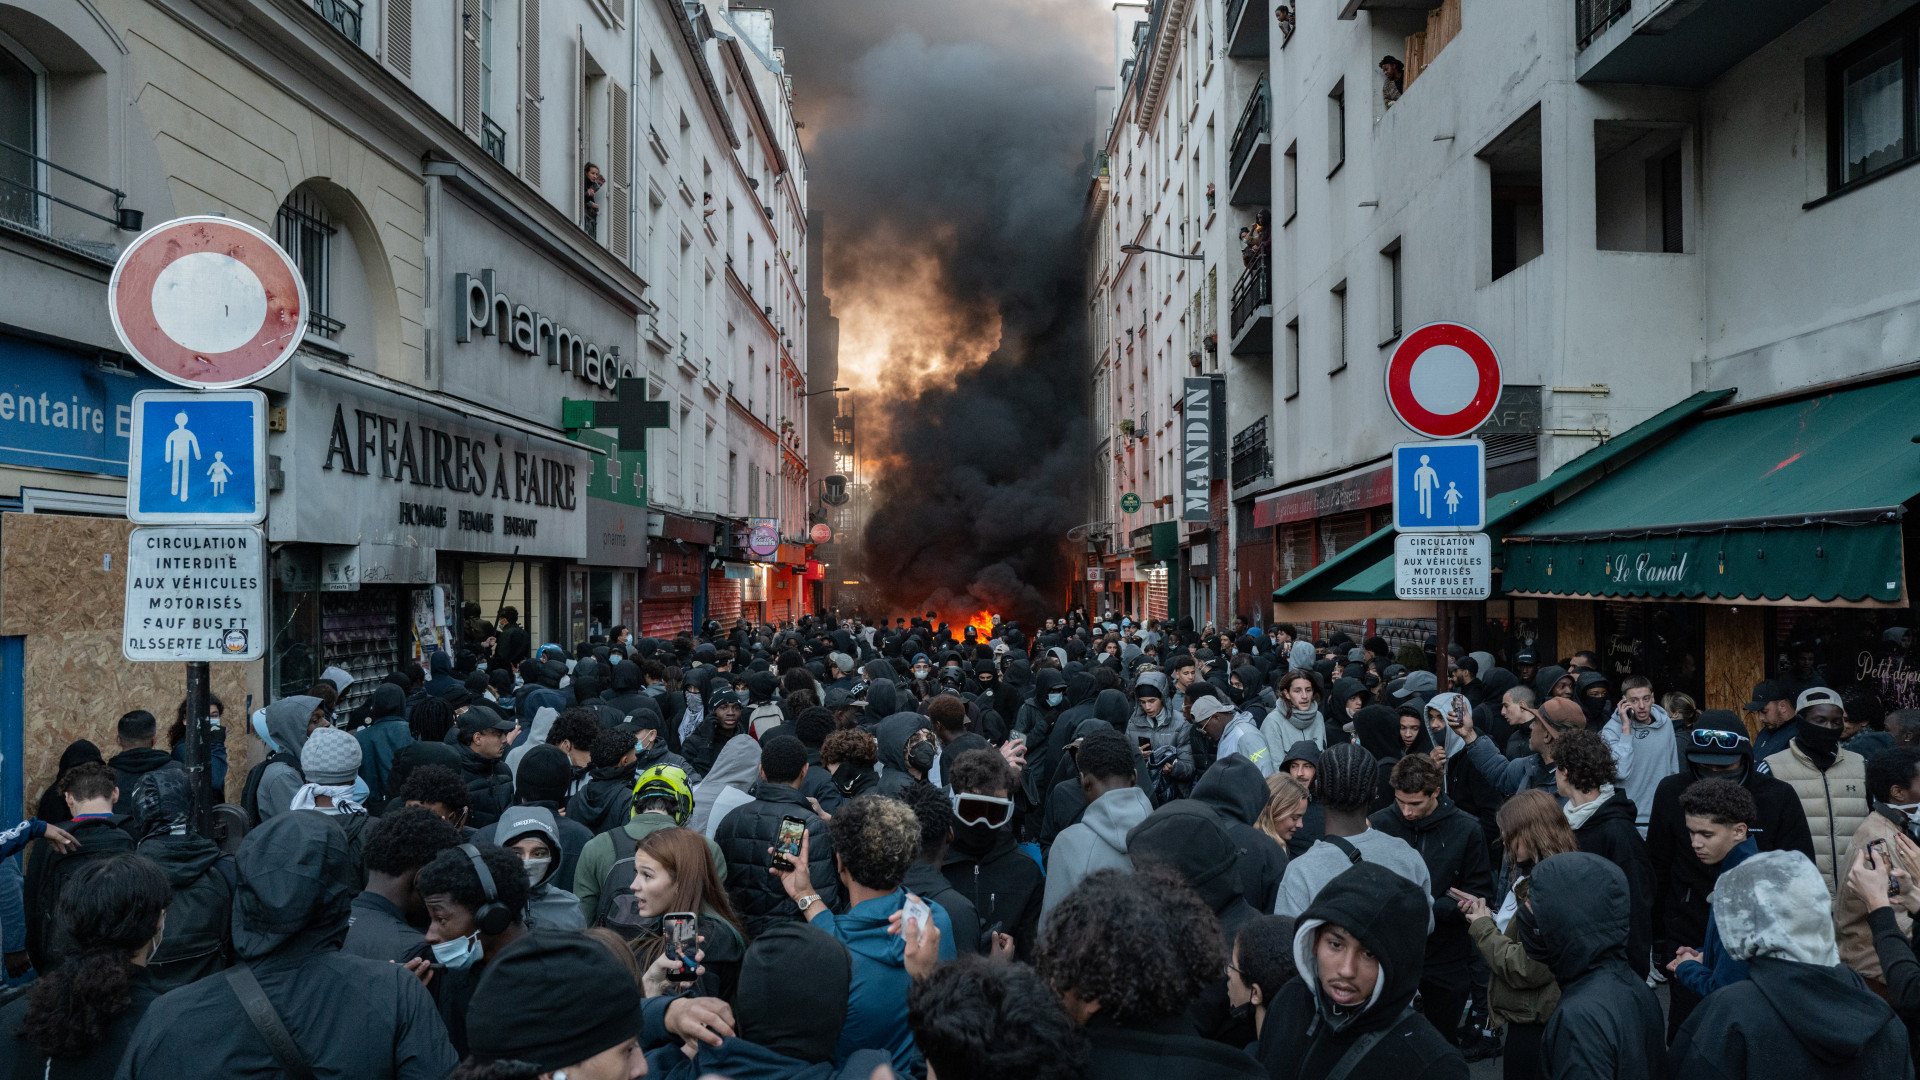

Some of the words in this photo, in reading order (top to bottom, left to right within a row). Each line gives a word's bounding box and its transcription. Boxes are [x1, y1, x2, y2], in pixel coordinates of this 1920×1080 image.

[0, 391, 104, 434] entaire
[116, 404, 131, 438] E
[1484, 410, 1534, 428] AFE
[1186, 386, 1209, 513] MANDIN
[322, 402, 487, 496] AFFAIRES
[514, 450, 576, 511] FAIRE
[399, 501, 447, 528] HOMME
[458, 509, 494, 533] FEMME
[503, 515, 538, 537] ENFANT
[147, 537, 247, 549] CIRCULATION
[1410, 538, 1475, 546] CIRCULATION
[1416, 548, 1468, 556] INTERDITE
[156, 557, 237, 569] INTERDITE
[1403, 558, 1422, 566] AUX
[1426, 556, 1482, 566] VÉHICULES
[1414, 567, 1471, 576] MOTORISÉS
[1612, 554, 1633, 583] Le
[1635, 552, 1689, 582] Canal
[134, 577, 165, 589] AUX
[172, 575, 257, 589] VÉHICULES
[1411, 577, 1436, 585] SAUF
[1440, 577, 1459, 585] BUS
[1462, 577, 1474, 585] ET
[1400, 587, 1448, 595] DESSERTE
[1451, 587, 1485, 595] LOCALE
[149, 595, 242, 609] MOTORISÉS
[143, 618, 186, 629] SAUF
[192, 618, 222, 629] BUS
